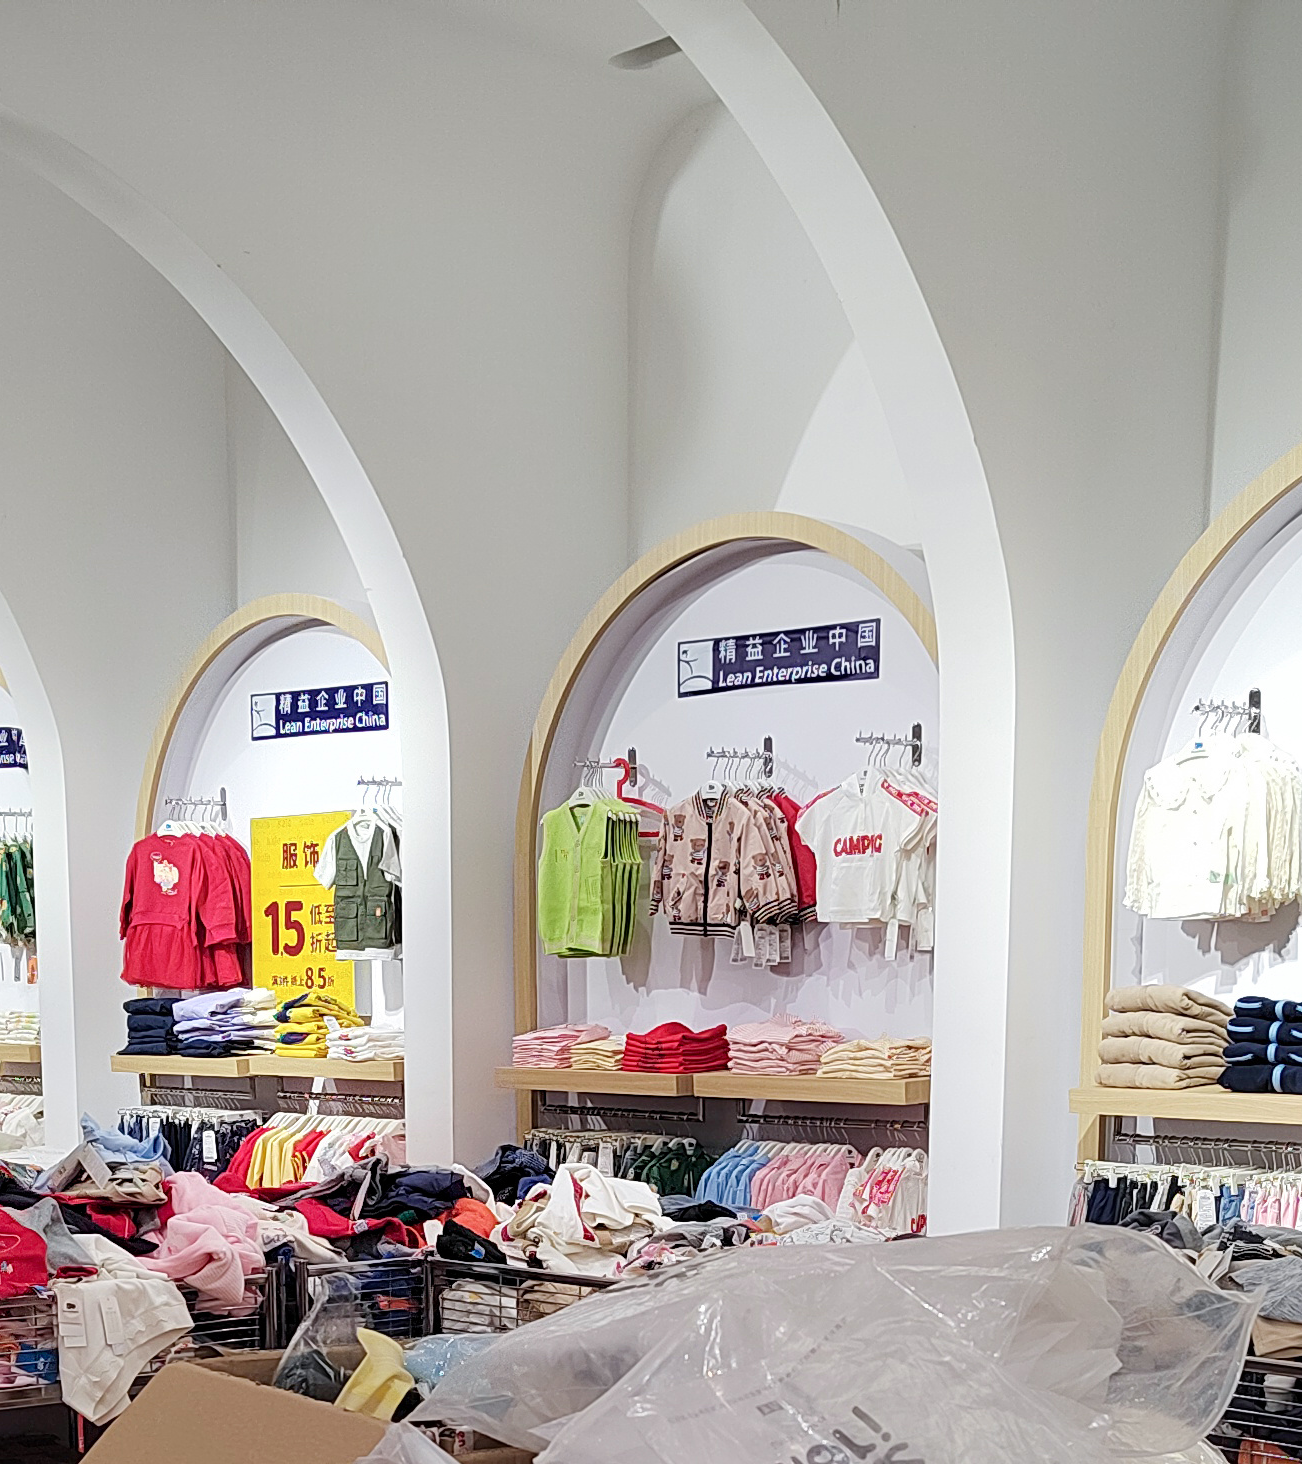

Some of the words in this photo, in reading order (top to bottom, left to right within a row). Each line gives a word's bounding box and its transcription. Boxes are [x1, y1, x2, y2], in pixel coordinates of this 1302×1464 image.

[718, 621, 877, 665] 精益企业中国
[718, 669, 751, 688] Lean
[755, 661, 828, 683] Enterprise
[830, 656, 875, 676] China
[279, 684, 387, 714] 精益企业中国
[279, 719, 303, 734] Lean
[304, 714, 354, 733] Enterprise
[355, 710, 386, 728] China
[281, 841, 320, 870] 服饰
[310, 904, 335, 926] 低至
[310, 931, 338, 954] 折起
